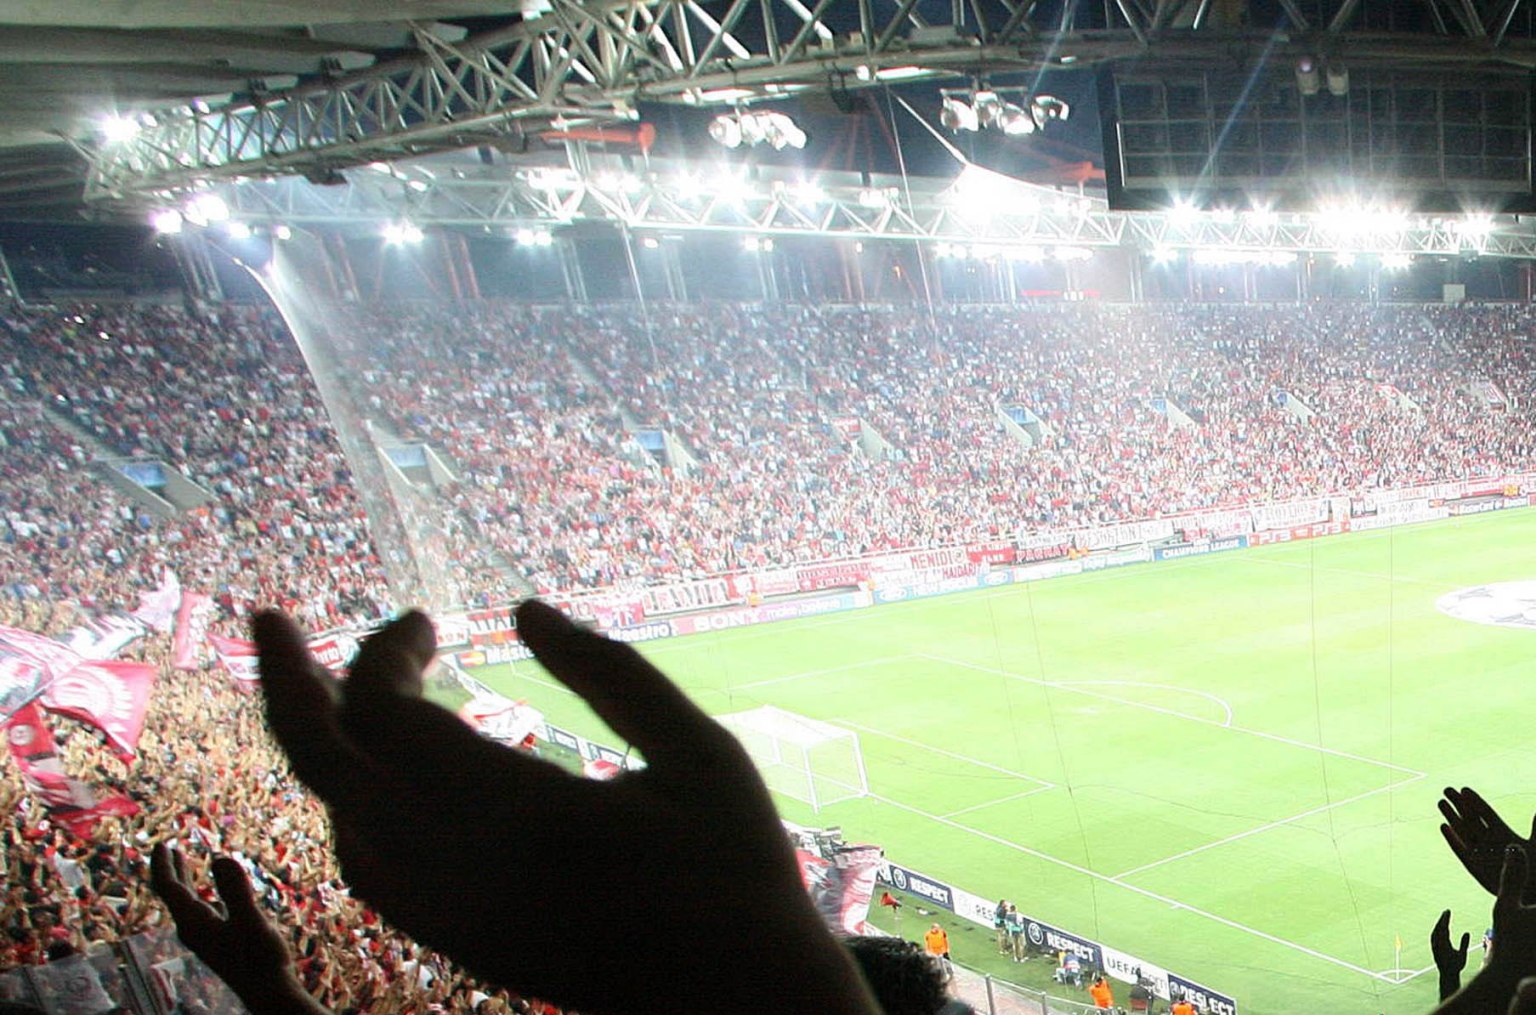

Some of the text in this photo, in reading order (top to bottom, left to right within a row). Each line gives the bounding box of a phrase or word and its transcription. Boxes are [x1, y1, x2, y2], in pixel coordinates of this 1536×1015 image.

[608, 624, 669, 642] Maestro
[694, 610, 762, 632] SONY
[909, 876, 949, 904] RESPECT
[1046, 932, 1095, 963] RESPECT
